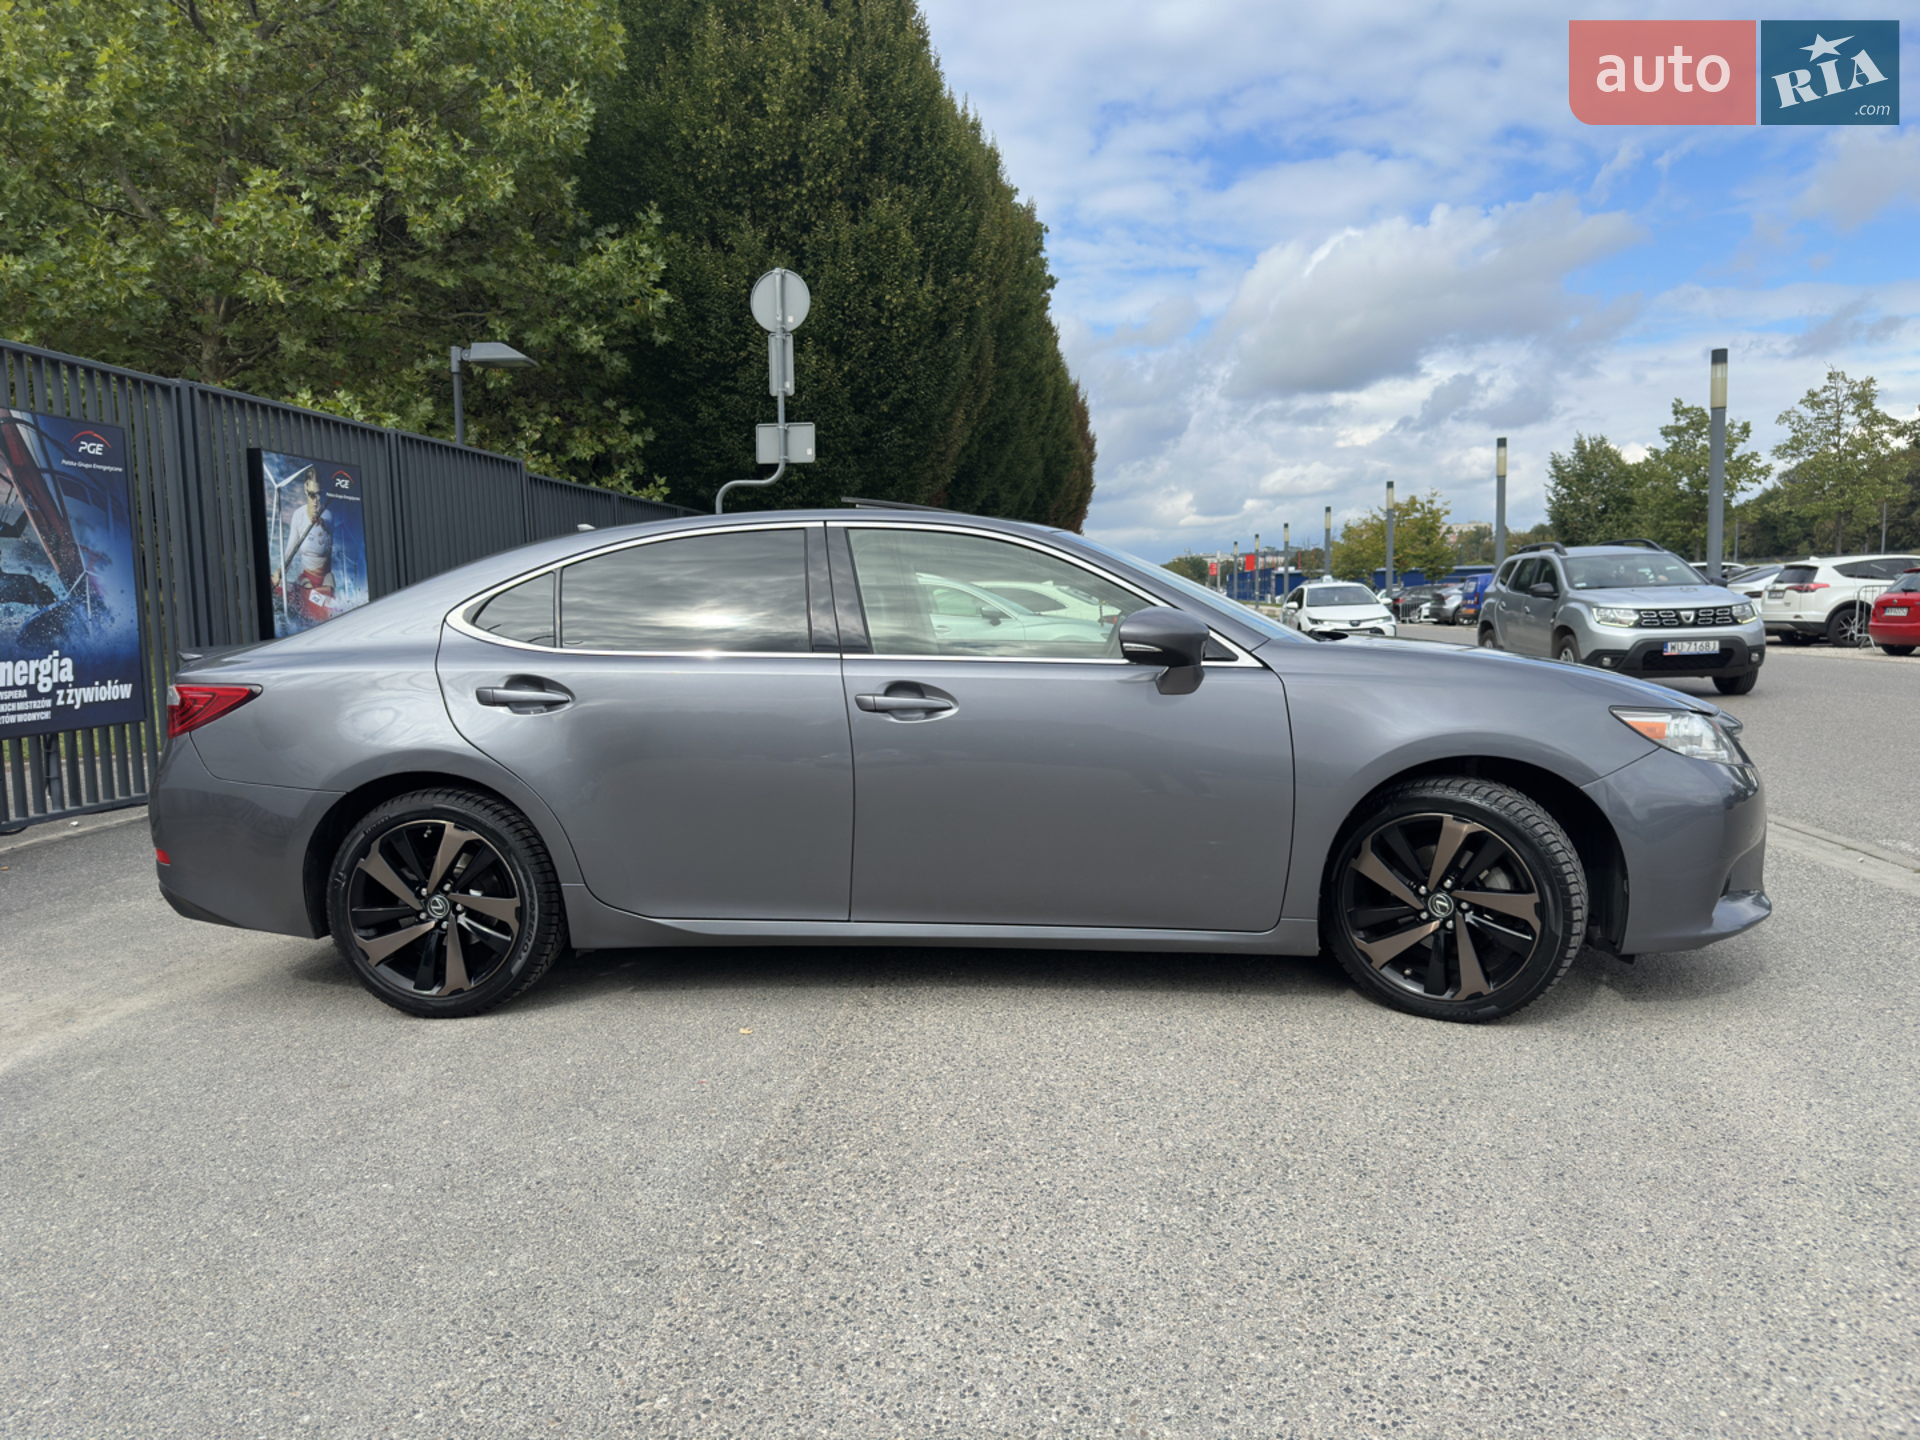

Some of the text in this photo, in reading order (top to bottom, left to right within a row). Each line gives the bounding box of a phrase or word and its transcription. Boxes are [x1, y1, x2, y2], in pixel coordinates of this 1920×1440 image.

[78, 441, 104, 456] PGE
[0, 650, 74, 693] nergia
[56, 680, 133, 710] z żywiołów
